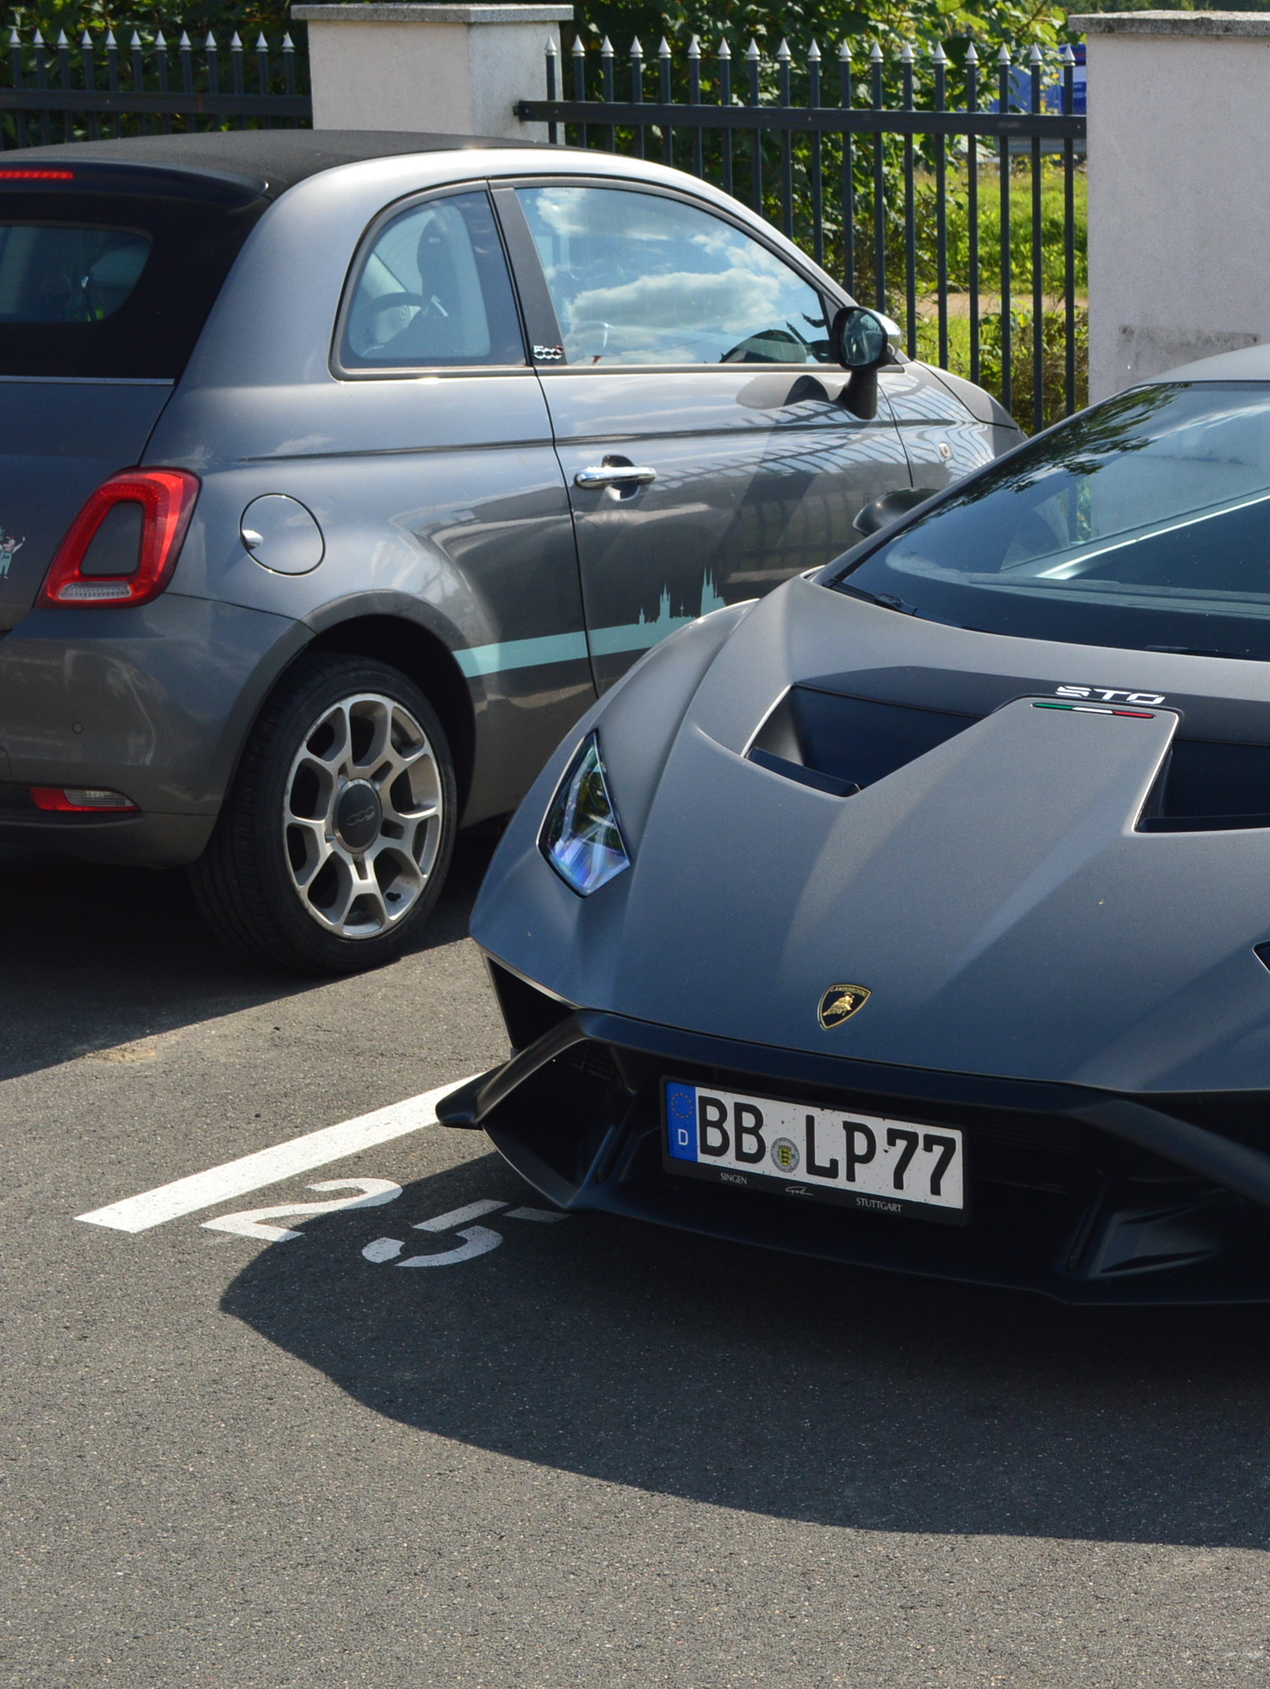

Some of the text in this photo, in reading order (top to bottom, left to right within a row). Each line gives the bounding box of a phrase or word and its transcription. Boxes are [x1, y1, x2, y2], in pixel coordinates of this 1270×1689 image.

[1055, 685, 1165, 705] STO
[677, 1128, 689, 1146] D
[697, 1094, 767, 1164] BB
[720, 1171, 748, 1185] SINGEN
[856, 1197, 902, 1214] STUTTGART
